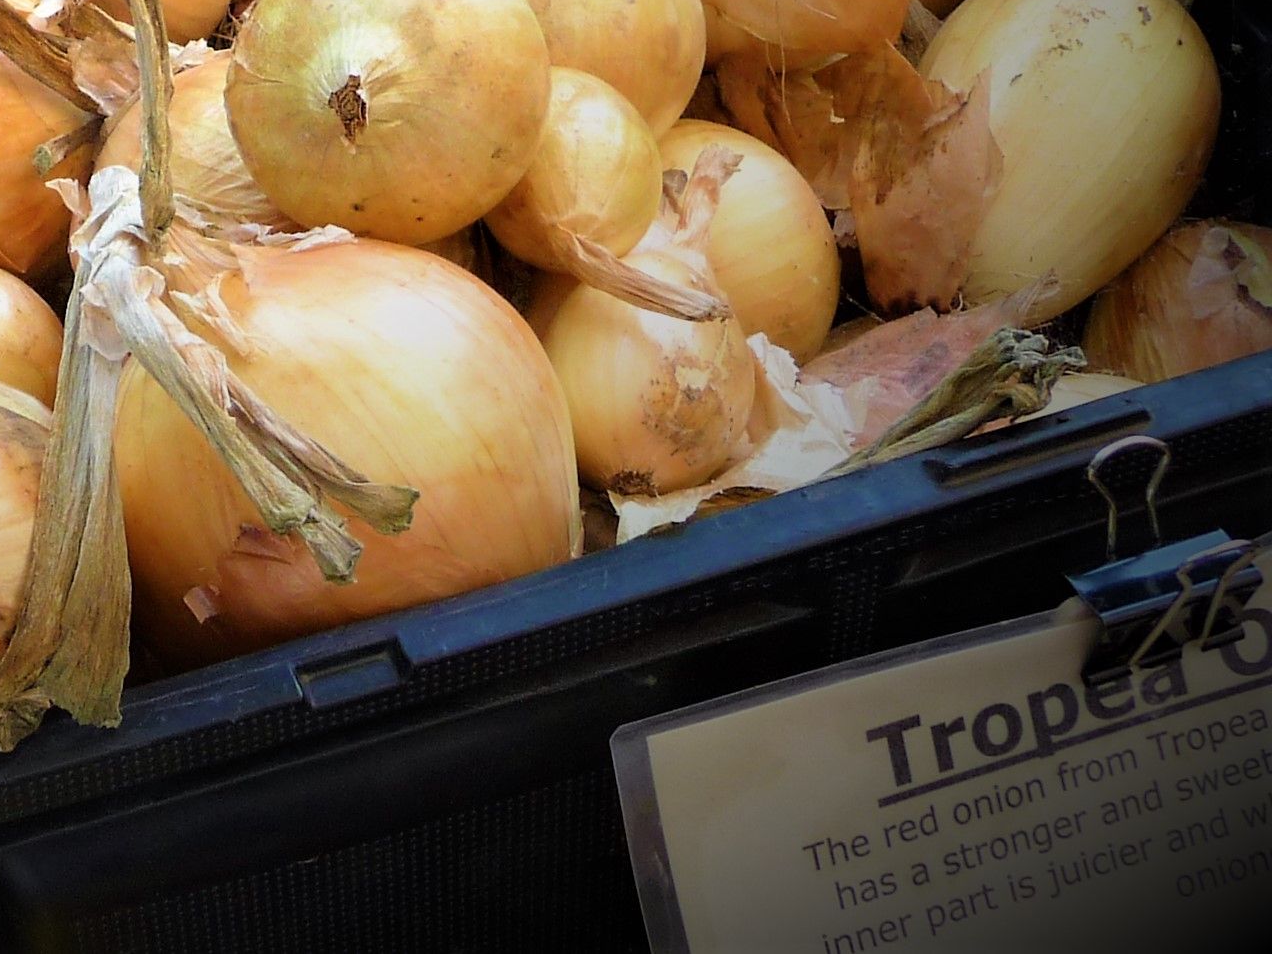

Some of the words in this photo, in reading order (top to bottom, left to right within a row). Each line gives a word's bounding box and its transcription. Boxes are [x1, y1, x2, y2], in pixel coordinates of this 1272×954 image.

[866, 657, 1188, 787] Tropea
[804, 835, 871, 871] The
[883, 805, 939, 848] red
[953, 778, 1046, 826] onion
[1057, 749, 1139, 792] from
[1145, 708, 1269, 761] Tropea
[835, 872, 898, 910] has
[912, 862, 931, 887] a
[943, 809, 1087, 866] stronger
[1100, 779, 1164, 826] and
[822, 914, 912, 954] inner
[926, 883, 1000, 937] part
[1006, 874, 1037, 902] is
[1046, 838, 1153, 899] juicier
[1166, 807, 1230, 854] and
[1176, 848, 1272, 898] onion
